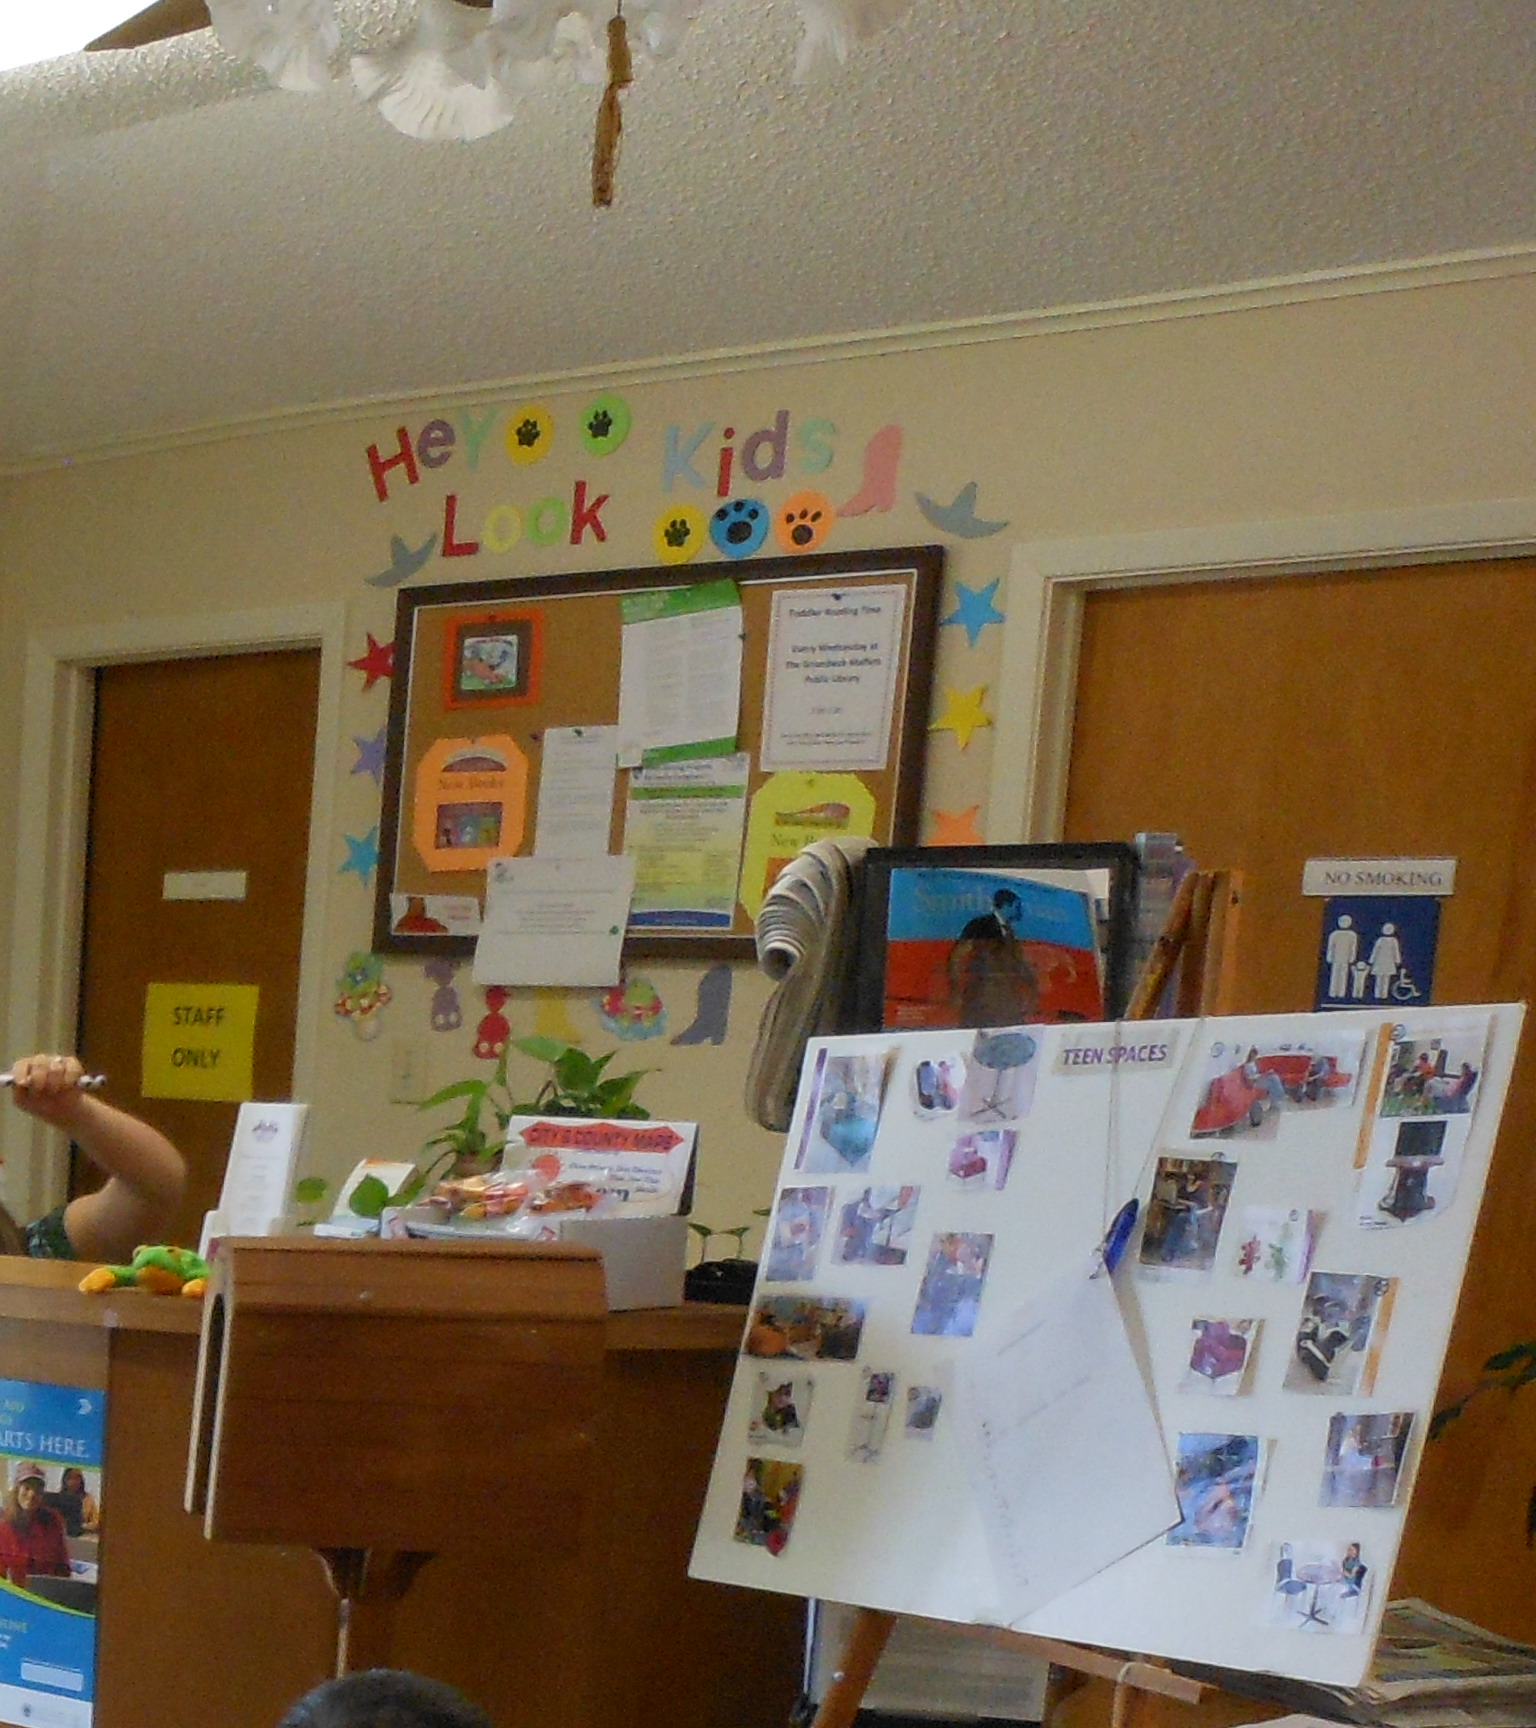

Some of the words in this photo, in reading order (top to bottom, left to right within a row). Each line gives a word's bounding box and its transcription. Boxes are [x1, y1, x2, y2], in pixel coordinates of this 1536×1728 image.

[664, 409, 837, 497] Kids
[442, 480, 611, 557] Look
[1325, 871, 1350, 885] NO
[1354, 870, 1442, 888] SMOKING
[174, 1006, 225, 1026] STAFF
[171, 1048, 220, 1068] ONLY
[1063, 1048, 1103, 1065] TEEN
[1106, 1044, 1167, 1064] SPACES
